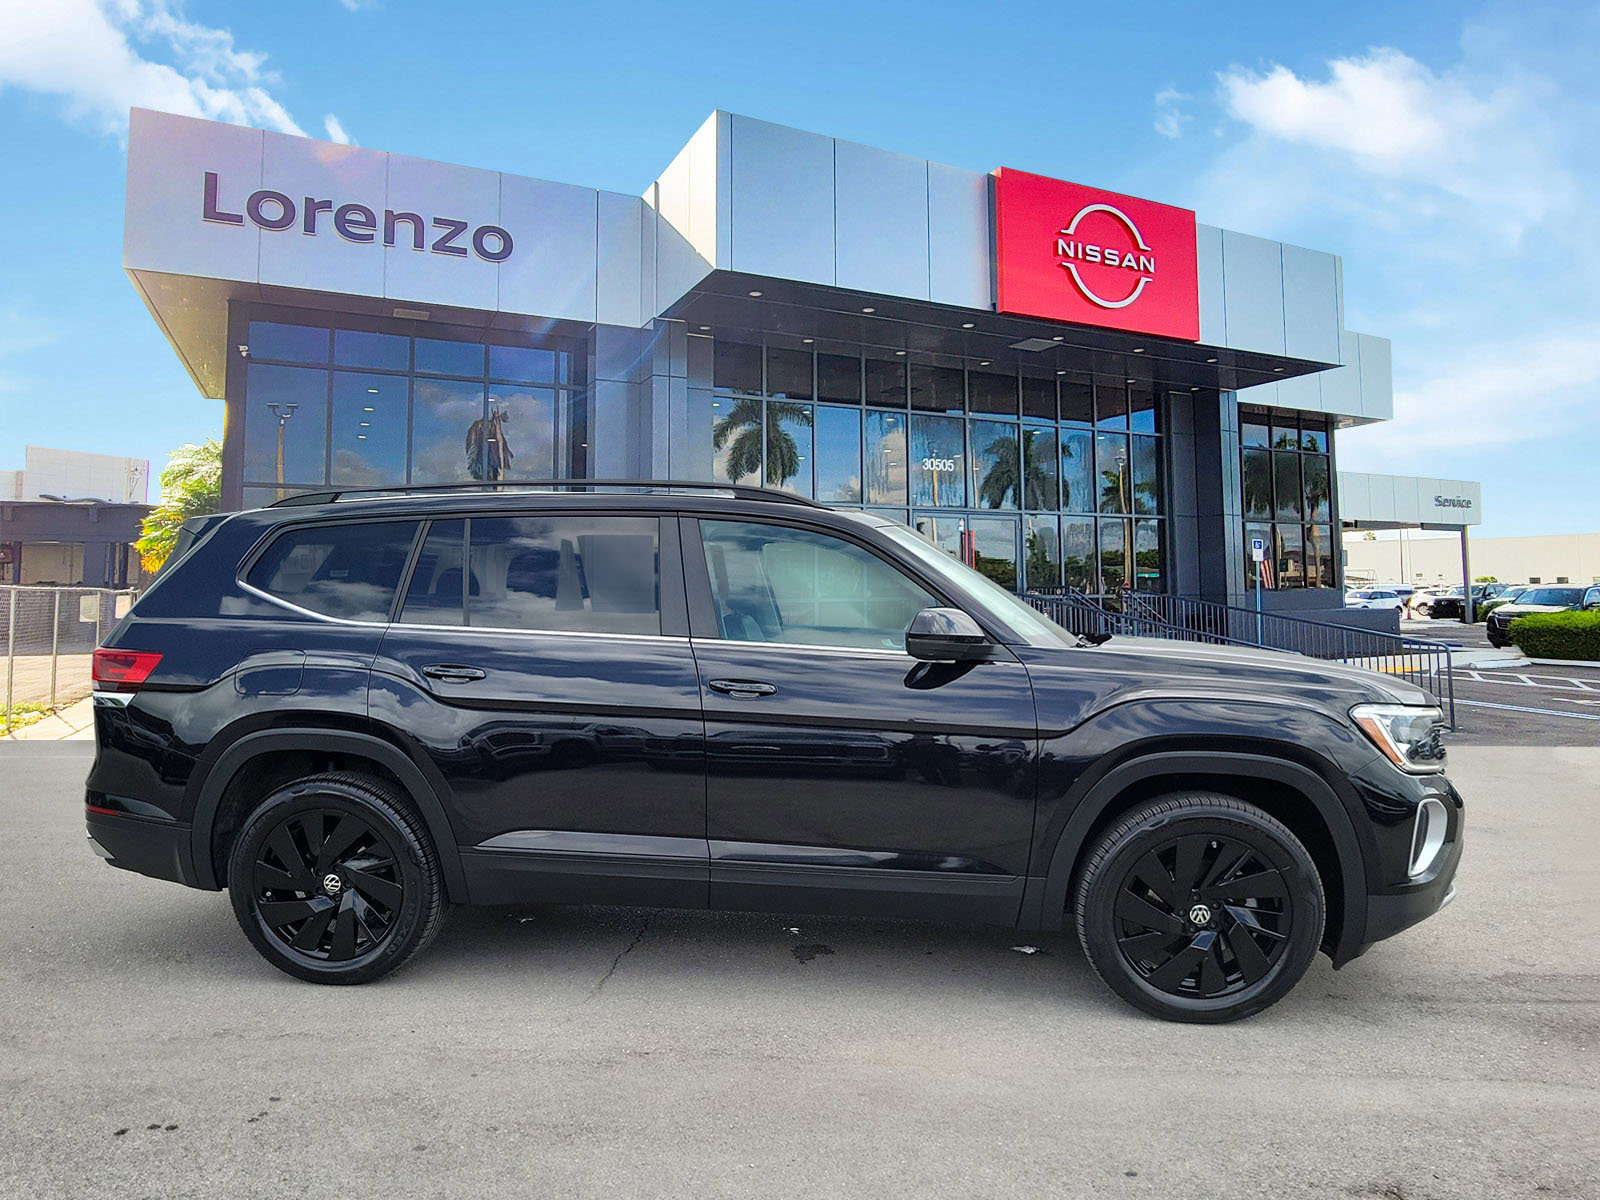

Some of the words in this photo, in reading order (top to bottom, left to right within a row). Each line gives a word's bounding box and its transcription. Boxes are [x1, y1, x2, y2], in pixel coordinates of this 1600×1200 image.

[203, 171, 514, 262] Lorenzo
[1057, 238, 1155, 273] NISSAN
[922, 458, 955, 471] 30505
[1434, 495, 1472, 509] Service
